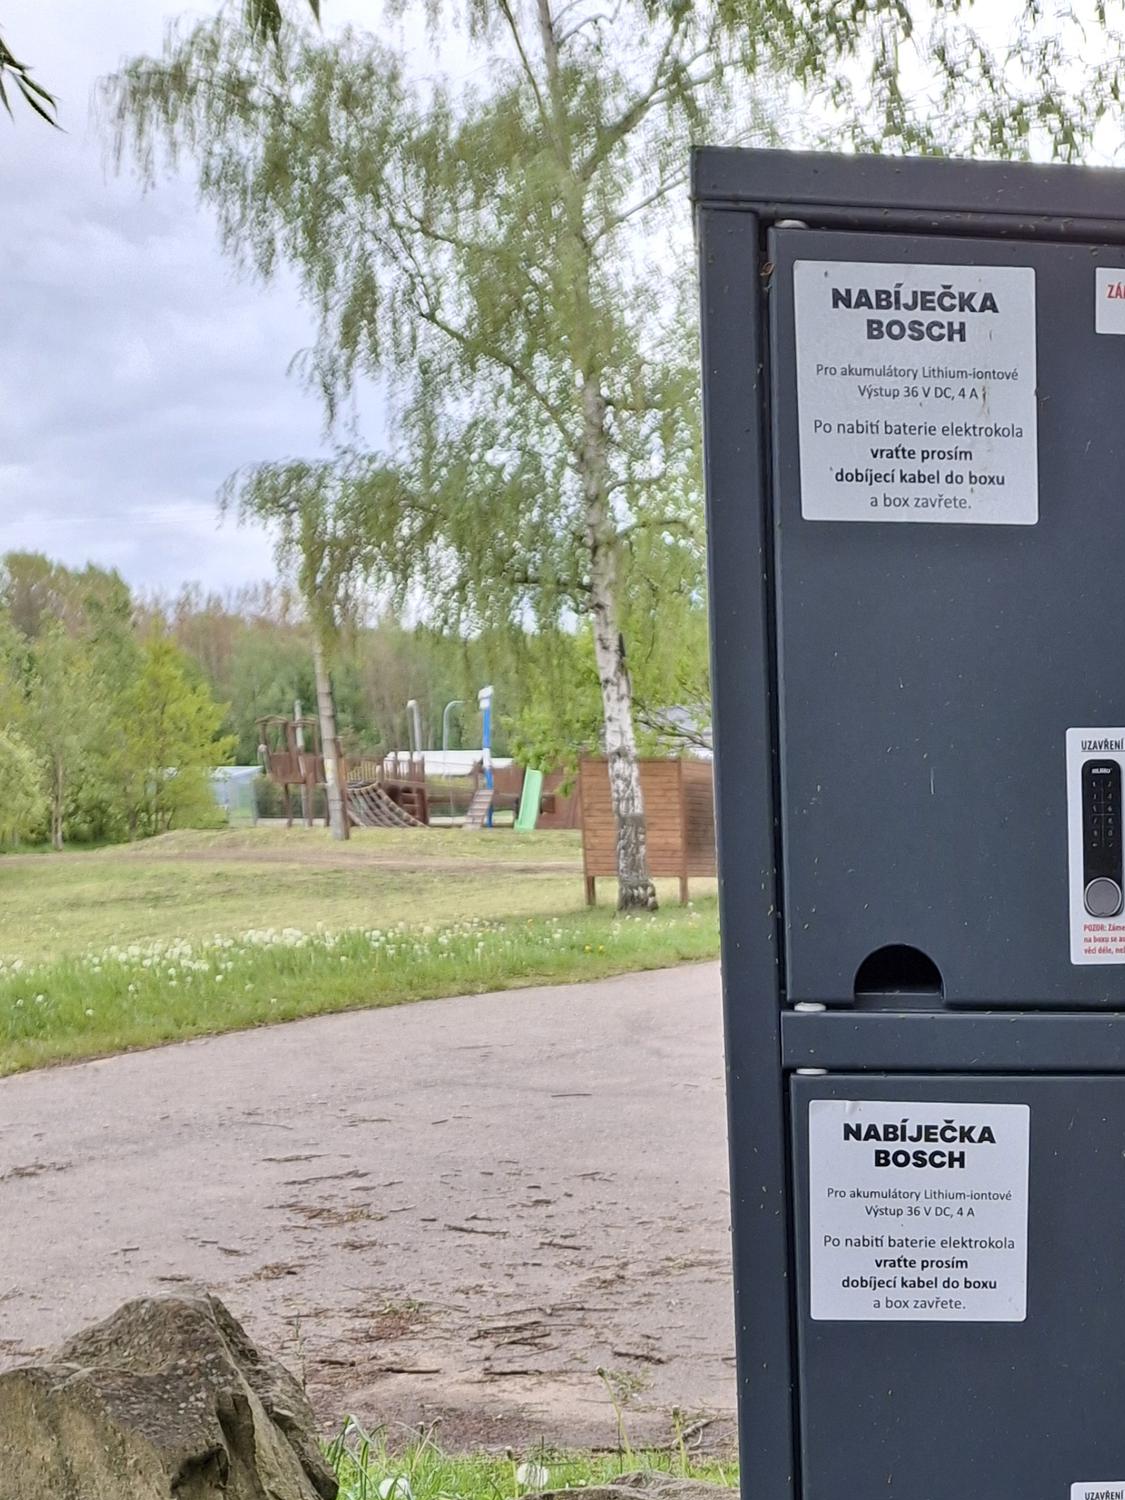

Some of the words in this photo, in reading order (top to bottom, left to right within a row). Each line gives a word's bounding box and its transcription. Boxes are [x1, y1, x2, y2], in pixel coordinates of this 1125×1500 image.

[832, 283, 999, 313] NABÍJEČKA
[866, 319, 966, 342] BOSCH
[816, 364, 837, 376] Pro
[840, 364, 918, 381] akumulátory
[922, 366, 1018, 381] Lithium-iontové
[857, 384, 900, 400] Výstup
[904, 386, 919, 398] 36
[922, 386, 931, 398] V
[934, 386, 955, 401] DC,
[958, 387, 966, 399] 4
[969, 387, 979, 399] A
[814, 419, 832, 434] Po
[837, 419, 880, 435] nabití
[884, 420, 937, 436] baterie
[941, 422, 1023, 438] elektrokola
[870, 444, 916, 459] vraťte
[921, 446, 972, 463] prosím
[835, 468, 895, 486] dobíjecí
[900, 469, 940, 484] kabel
[945, 470, 964, 485] do
[969, 470, 1005, 485] boxu
[870, 496, 878, 507] a
[883, 493, 910, 507] box
[914, 493, 971, 509] zavřete.
[1081, 738, 1125, 750] UZAVŘENÍ
[843, 1118, 996, 1144] NABÍJEČKA
[875, 1149, 965, 1169] BOSCH
[827, 1188, 846, 1198] Pro
[849, 1188, 921, 1201] akumulátory
[924, 1189, 1012, 1201] Lithium-iontové
[865, 1205, 903, 1218] Výstup
[907, 1206, 921, 1216] 36
[923, 1206, 932, 1216] V
[935, 1206, 953, 1219] DC,
[956, 1207, 963, 1216] 4
[966, 1207, 975, 1217] A
[824, 1235, 841, 1247] Po
[845, 1235, 884, 1248] nabití
[888, 1235, 936, 1248] baterie
[940, 1236, 1015, 1249] elektrokola
[875, 1255, 916, 1268] vraťte
[921, 1256, 968, 1271] prosím
[842, 1276, 897, 1291] dobíjecí
[901, 1276, 938, 1289] kabel
[942, 1277, 960, 1289] do
[964, 1277, 997, 1289] boxu
[873, 1299, 881, 1309] a
[885, 1296, 909, 1309] box
[913, 1297, 966, 1309] zavřete.
[1084, 1489, 1124, 1500] UZAVŘENÍ
